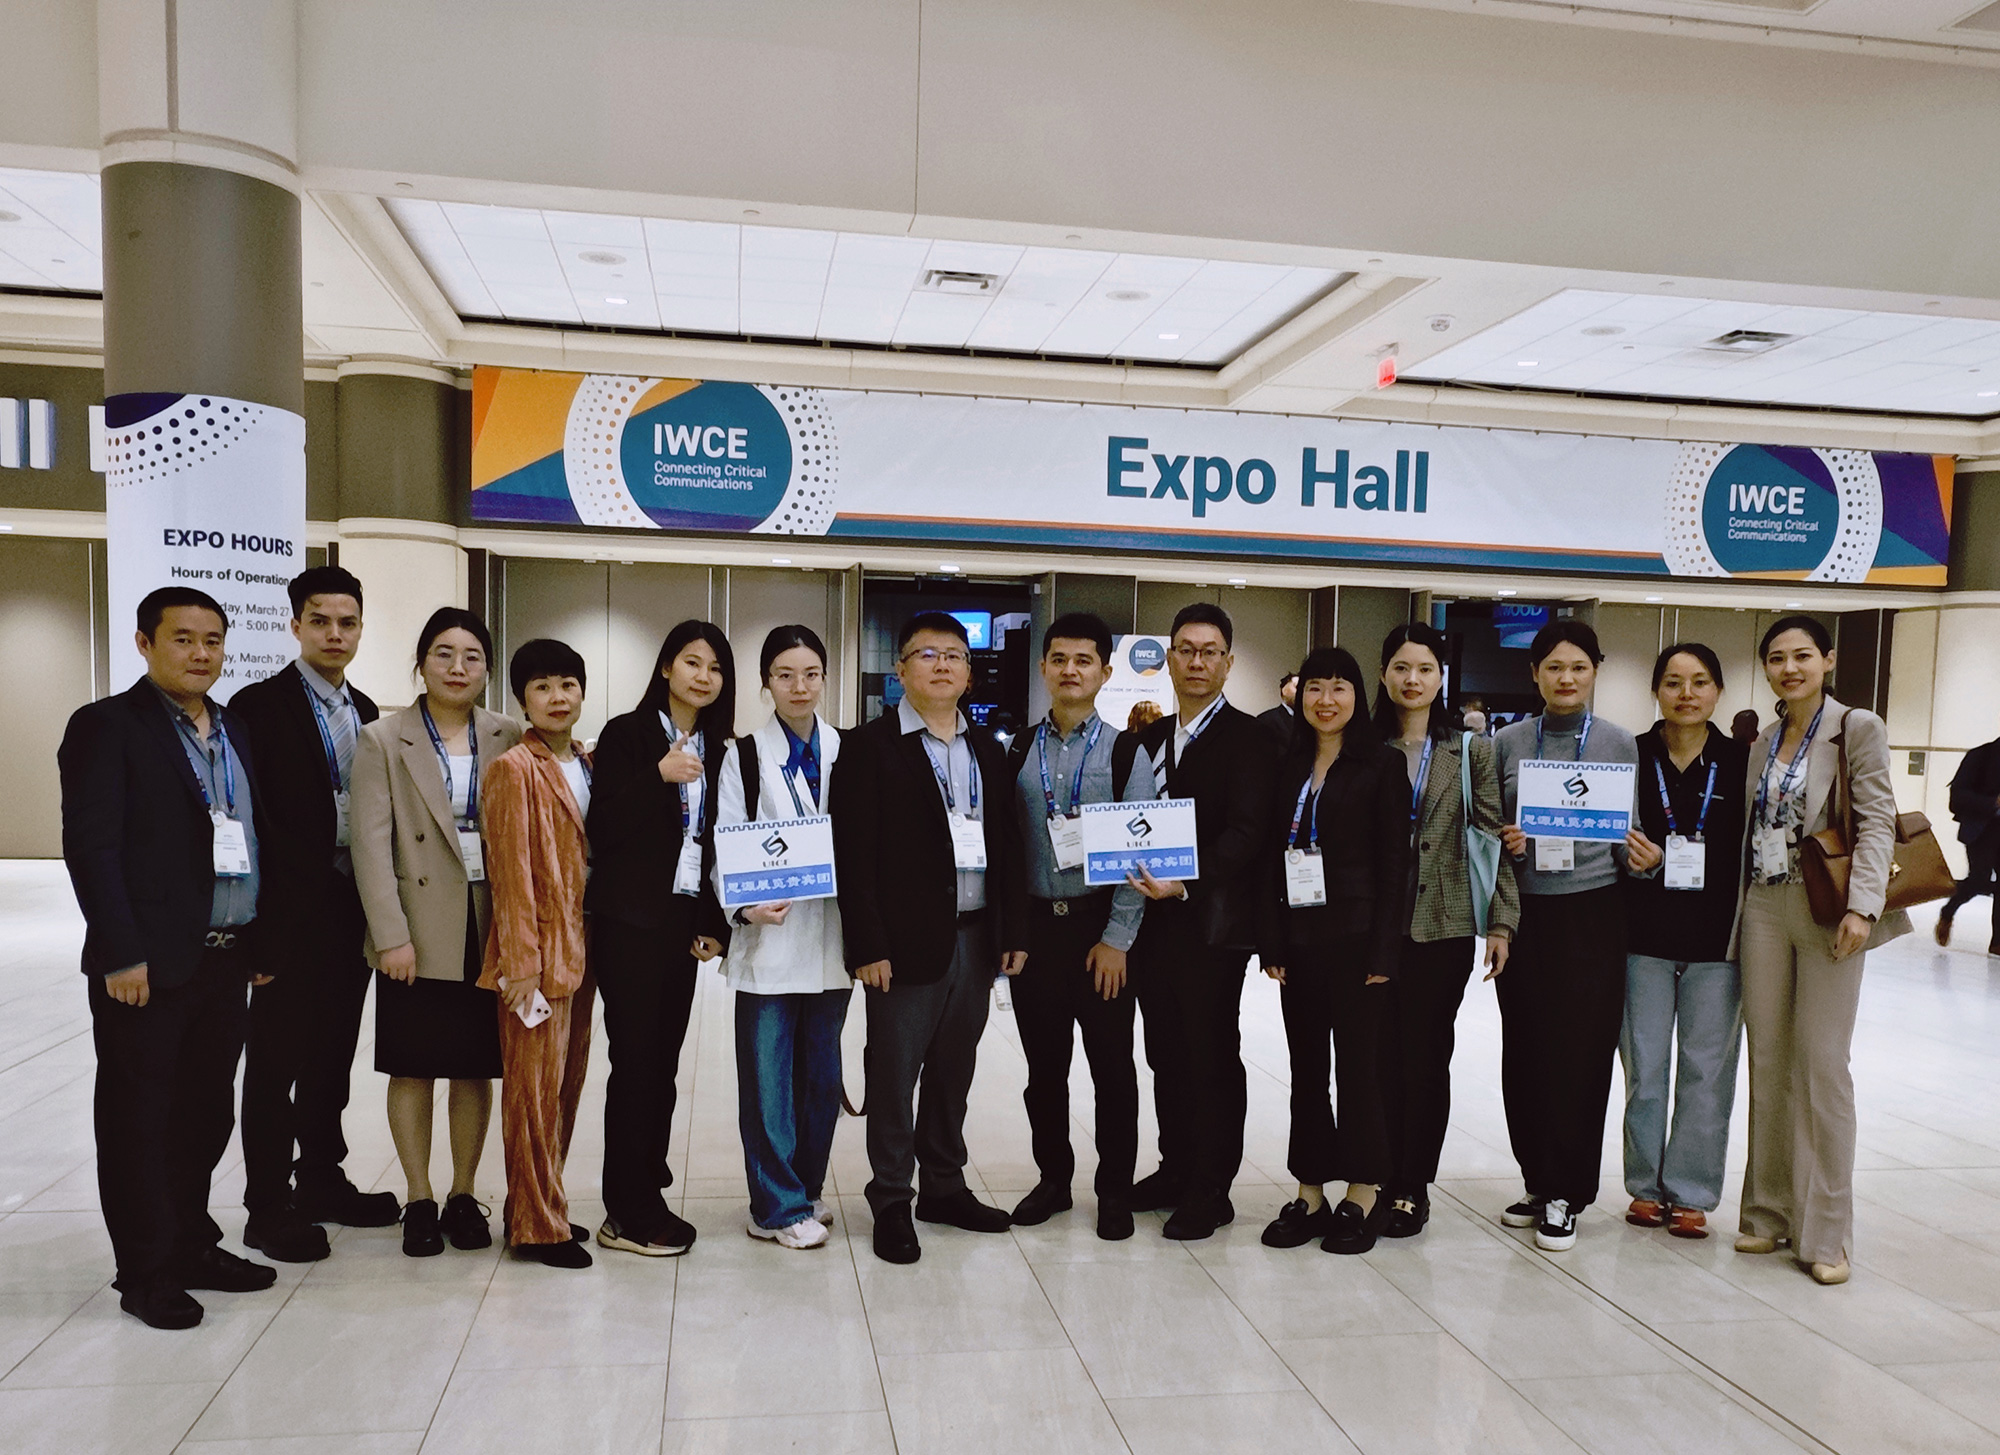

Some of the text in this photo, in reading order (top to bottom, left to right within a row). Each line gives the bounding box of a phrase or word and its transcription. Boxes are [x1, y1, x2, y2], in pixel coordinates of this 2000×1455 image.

[654, 423, 748, 459] IWCE
[654, 460, 767, 478] Connecting Critical
[1107, 436, 1429, 517] Expo Hall
[654, 474, 753, 490] Communications
[1729, 483, 1805, 515] IWCE
[1728, 516, 1819, 532] Connecting Critical
[163, 529, 293, 557] EXPO HOURS
[1728, 529, 1807, 543] Communications
[171, 566, 290, 586] Hours of Operation
[220, 602, 289, 617] day, March 27
[246, 620, 268, 631] 5:00
[271, 621, 286, 632] PM
[240, 652, 273, 664] March
[275, 654, 286, 665] 28
[245, 669, 267, 679] 4:00
